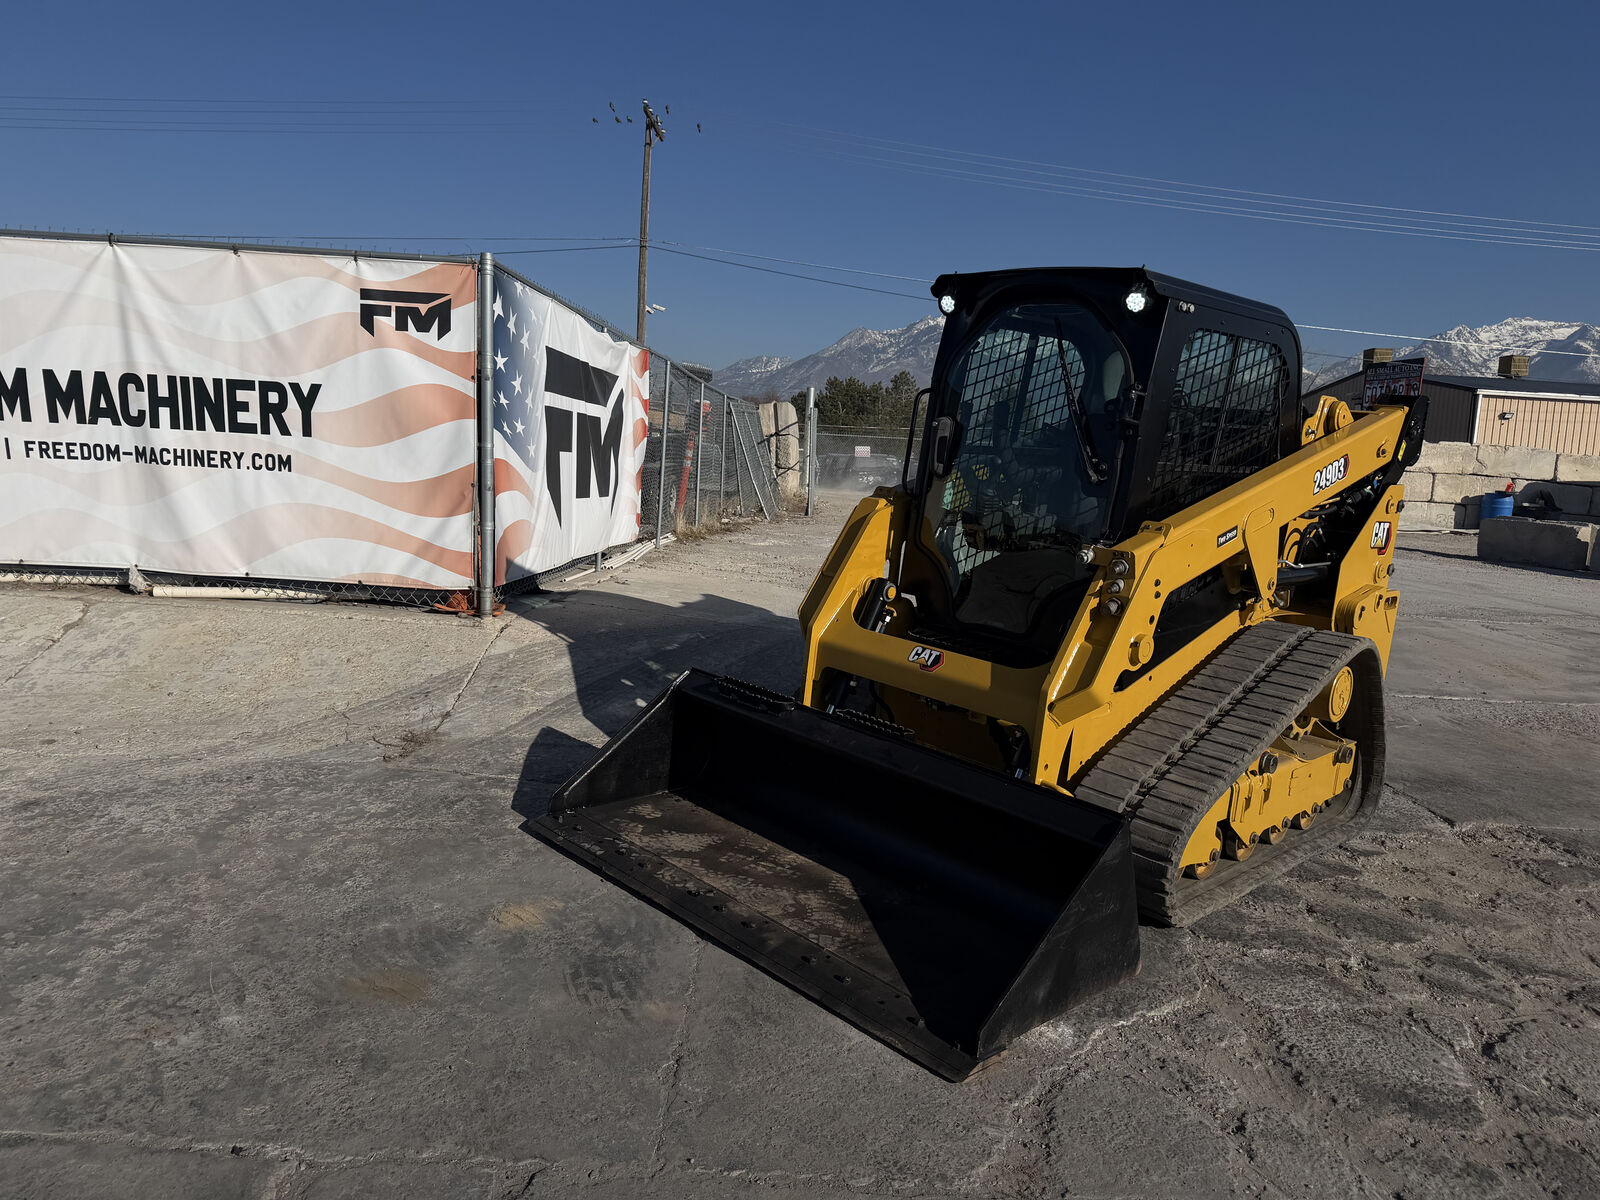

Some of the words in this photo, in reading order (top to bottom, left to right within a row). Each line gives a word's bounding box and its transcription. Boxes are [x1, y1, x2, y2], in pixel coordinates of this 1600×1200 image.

[360, 288, 451, 341] FM
[42, 368, 322, 438] MACHINERY
[24, 440, 292, 472] FREEDOM-MACHINERY.COM
[544, 345, 624, 529] FM
[1313, 457, 1345, 495] 249D3
[1371, 521, 1390, 548] CAT
[908, 646, 941, 666] CAT
